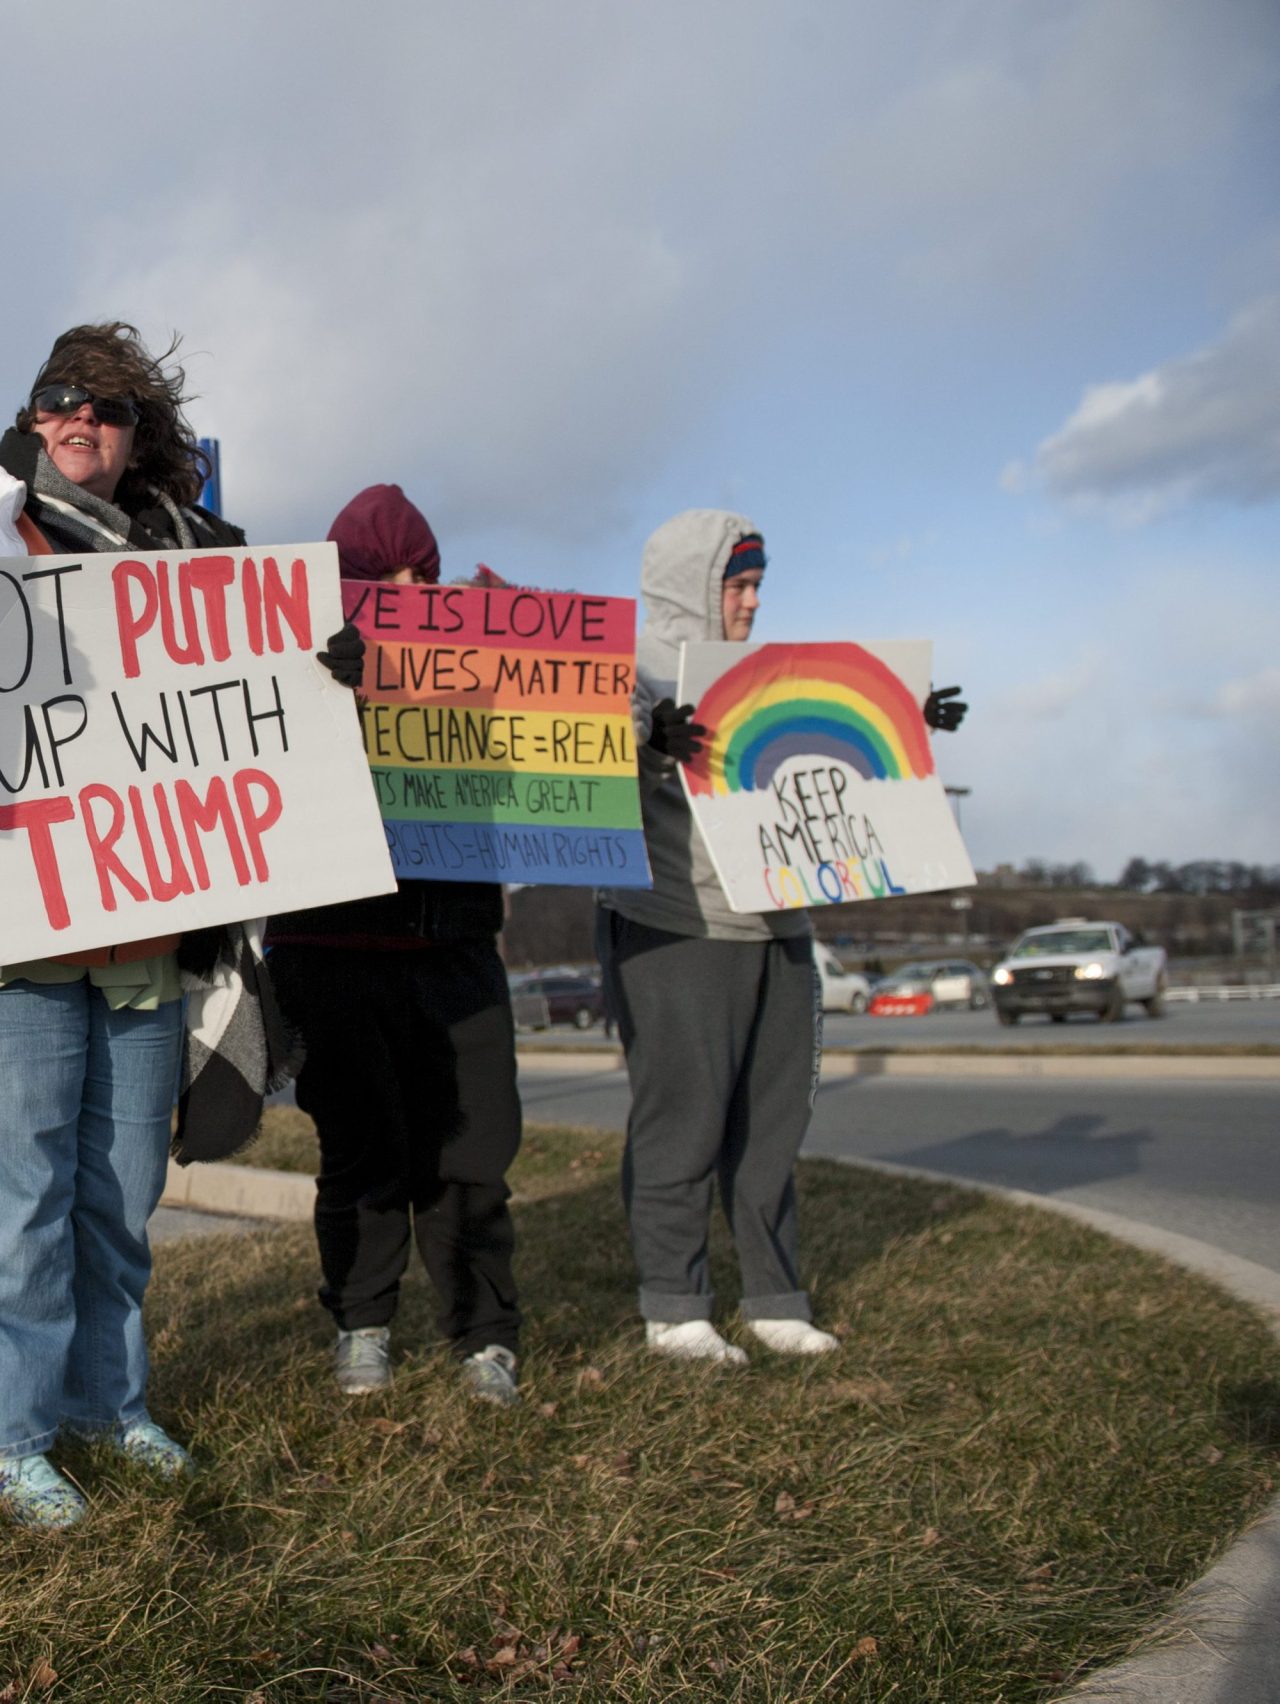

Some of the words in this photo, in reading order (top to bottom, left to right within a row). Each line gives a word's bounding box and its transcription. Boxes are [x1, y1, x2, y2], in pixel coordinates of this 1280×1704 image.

[111, 556, 313, 678] PUTIN
[418, 589, 465, 633] IS
[483, 592, 608, 641] LOVE
[376, 645, 481, 692] LIVES
[111, 676, 289, 772] WITH
[403, 771, 448, 809] MAKE
[454, 773, 520, 809] AMERICA
[526, 778, 601, 814] GREAT
[772, 766, 847, 822] KEEP
[552, 831, 628, 869] RIGHTS
[759, 813, 885, 867] AMERICA
[764, 855, 907, 910] COLORFUL
